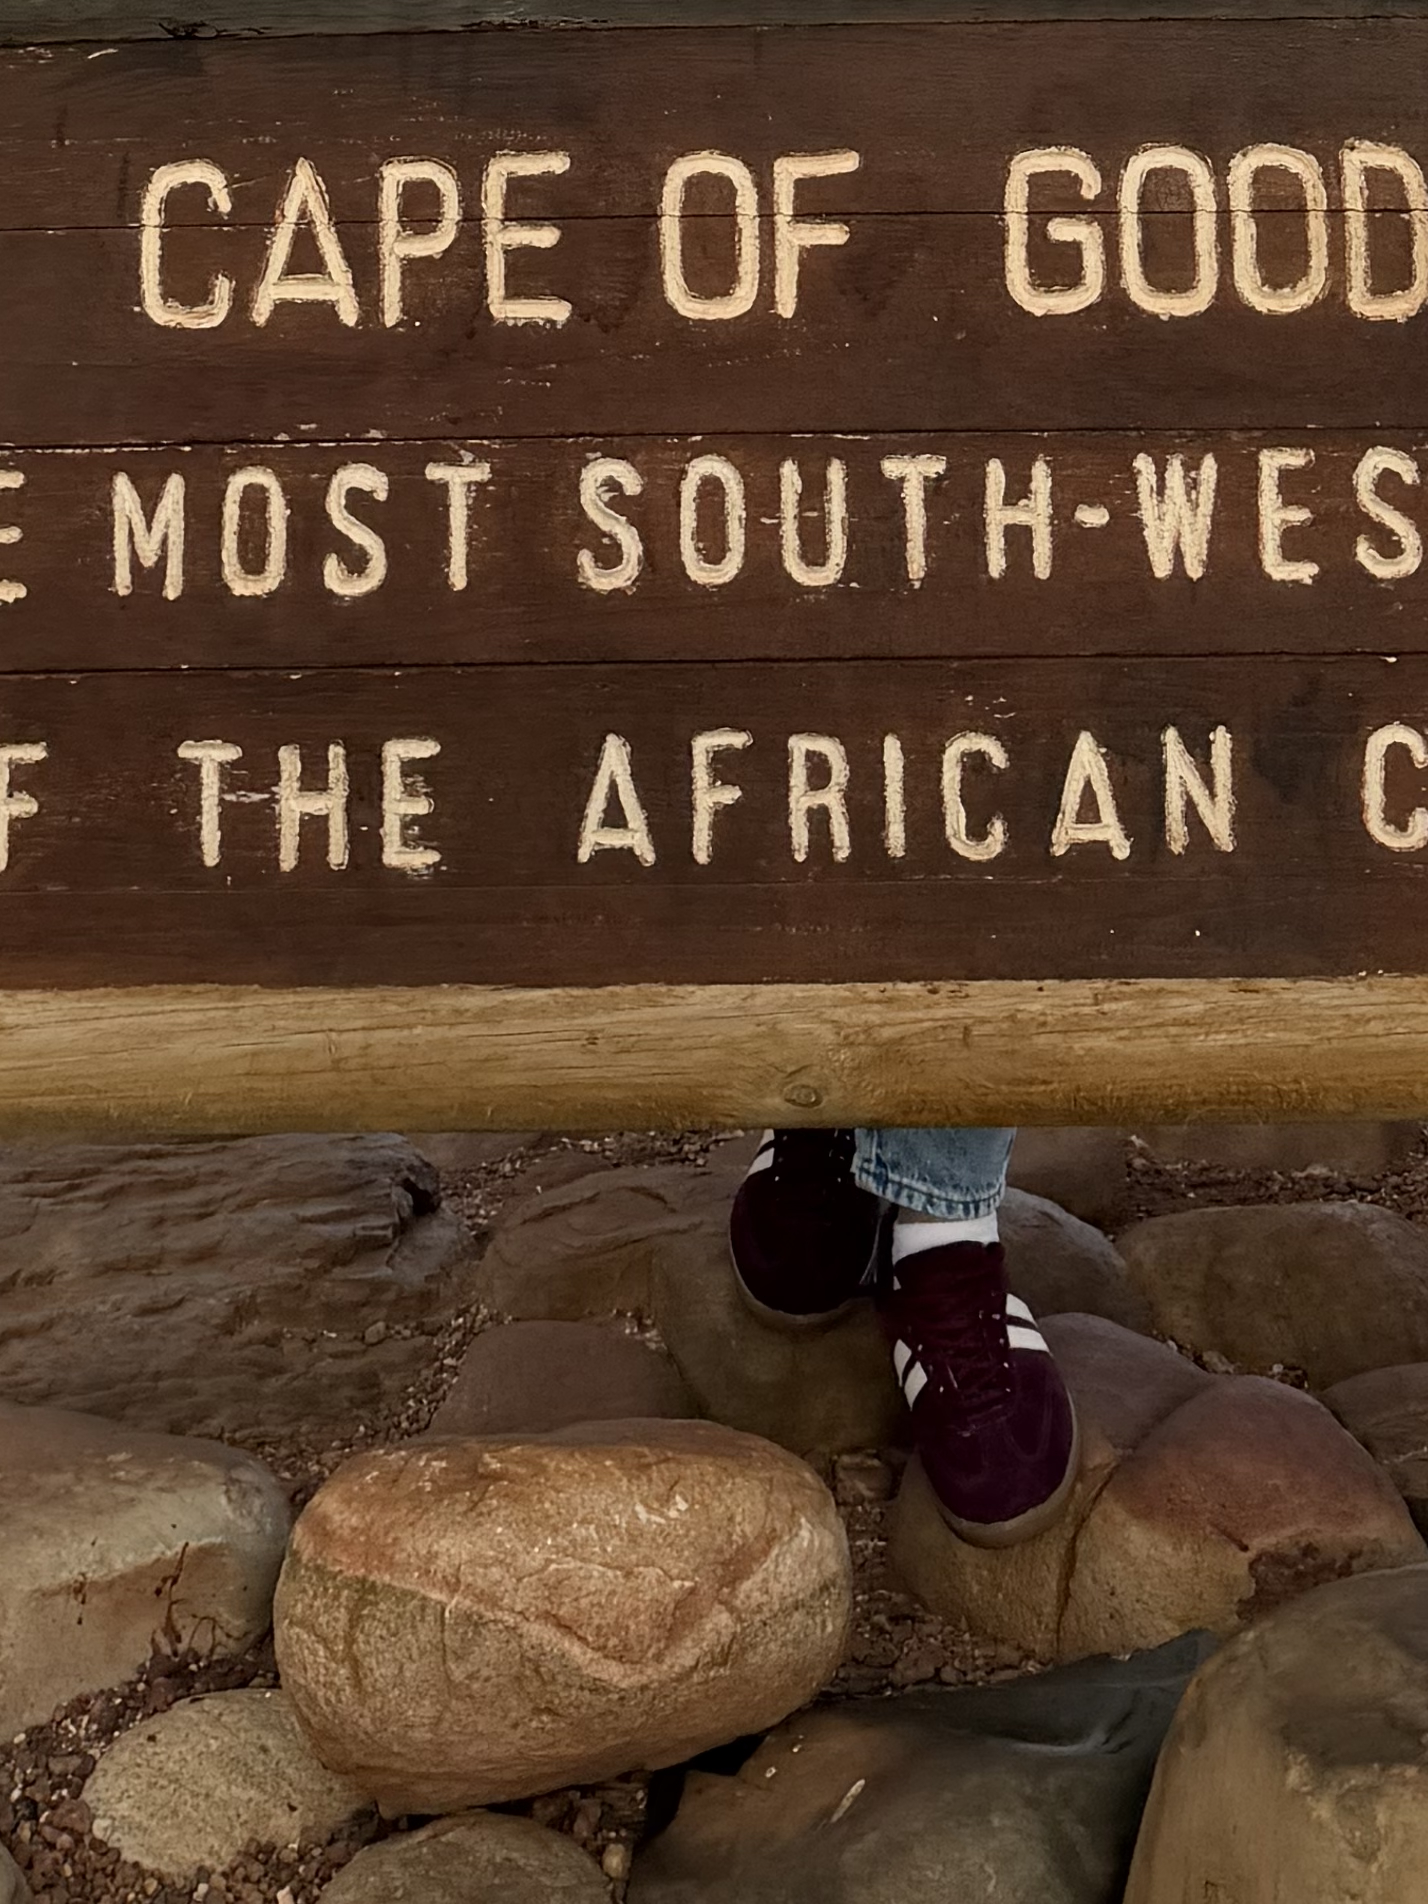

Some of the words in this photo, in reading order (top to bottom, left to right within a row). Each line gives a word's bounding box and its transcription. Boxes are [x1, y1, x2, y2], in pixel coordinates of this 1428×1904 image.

[137, 149, 574, 331] CAPE
[657, 148, 861, 322] OF
[110, 460, 494, 602] MOST
[176, 737, 443, 876] THE
[576, 724, 1239, 868] AFRICAN
